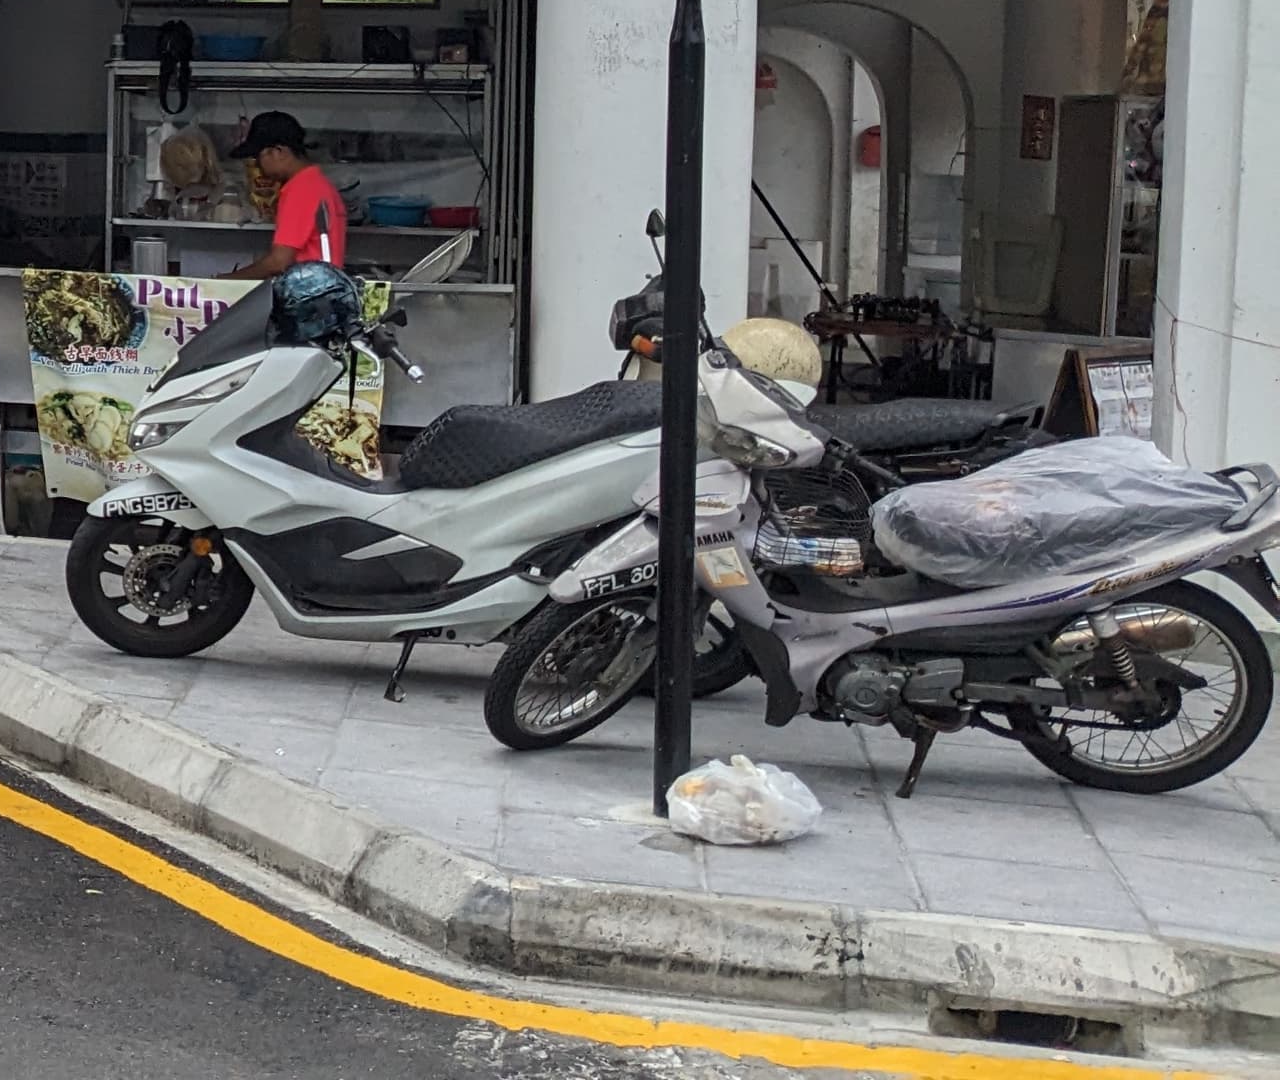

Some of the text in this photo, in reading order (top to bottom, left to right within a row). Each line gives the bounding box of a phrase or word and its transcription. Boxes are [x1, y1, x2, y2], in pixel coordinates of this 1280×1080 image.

[138, 279, 200, 309] Put
[111, 364, 141, 375] Thick
[696, 530, 735, 547] AMAHA
